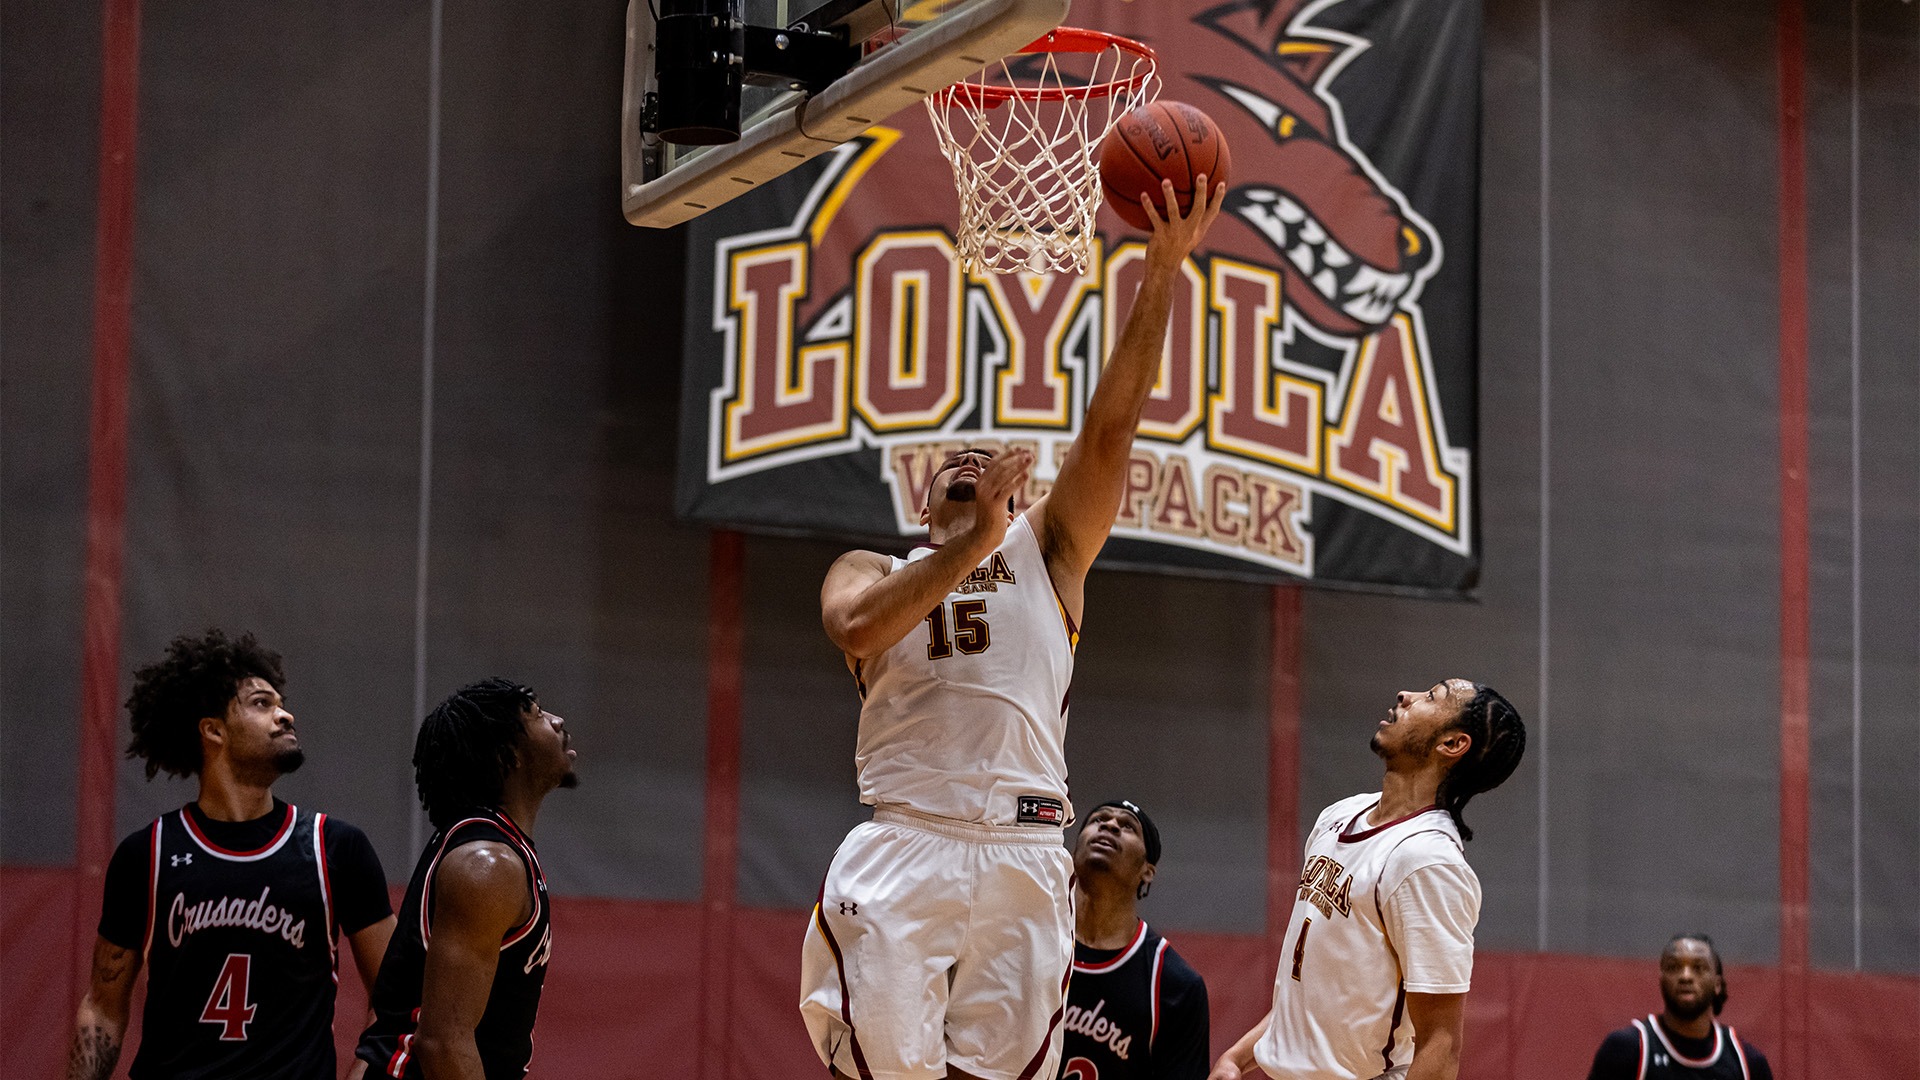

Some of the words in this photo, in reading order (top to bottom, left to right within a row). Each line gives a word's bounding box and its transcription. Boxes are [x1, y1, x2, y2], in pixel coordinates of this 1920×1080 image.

[724, 231, 1456, 536] LOYOLA
[925, 599, 991, 660] 15
[168, 886, 305, 948] Crusaders
[199, 953, 258, 1041] 4
[1064, 999, 1132, 1060] aders
